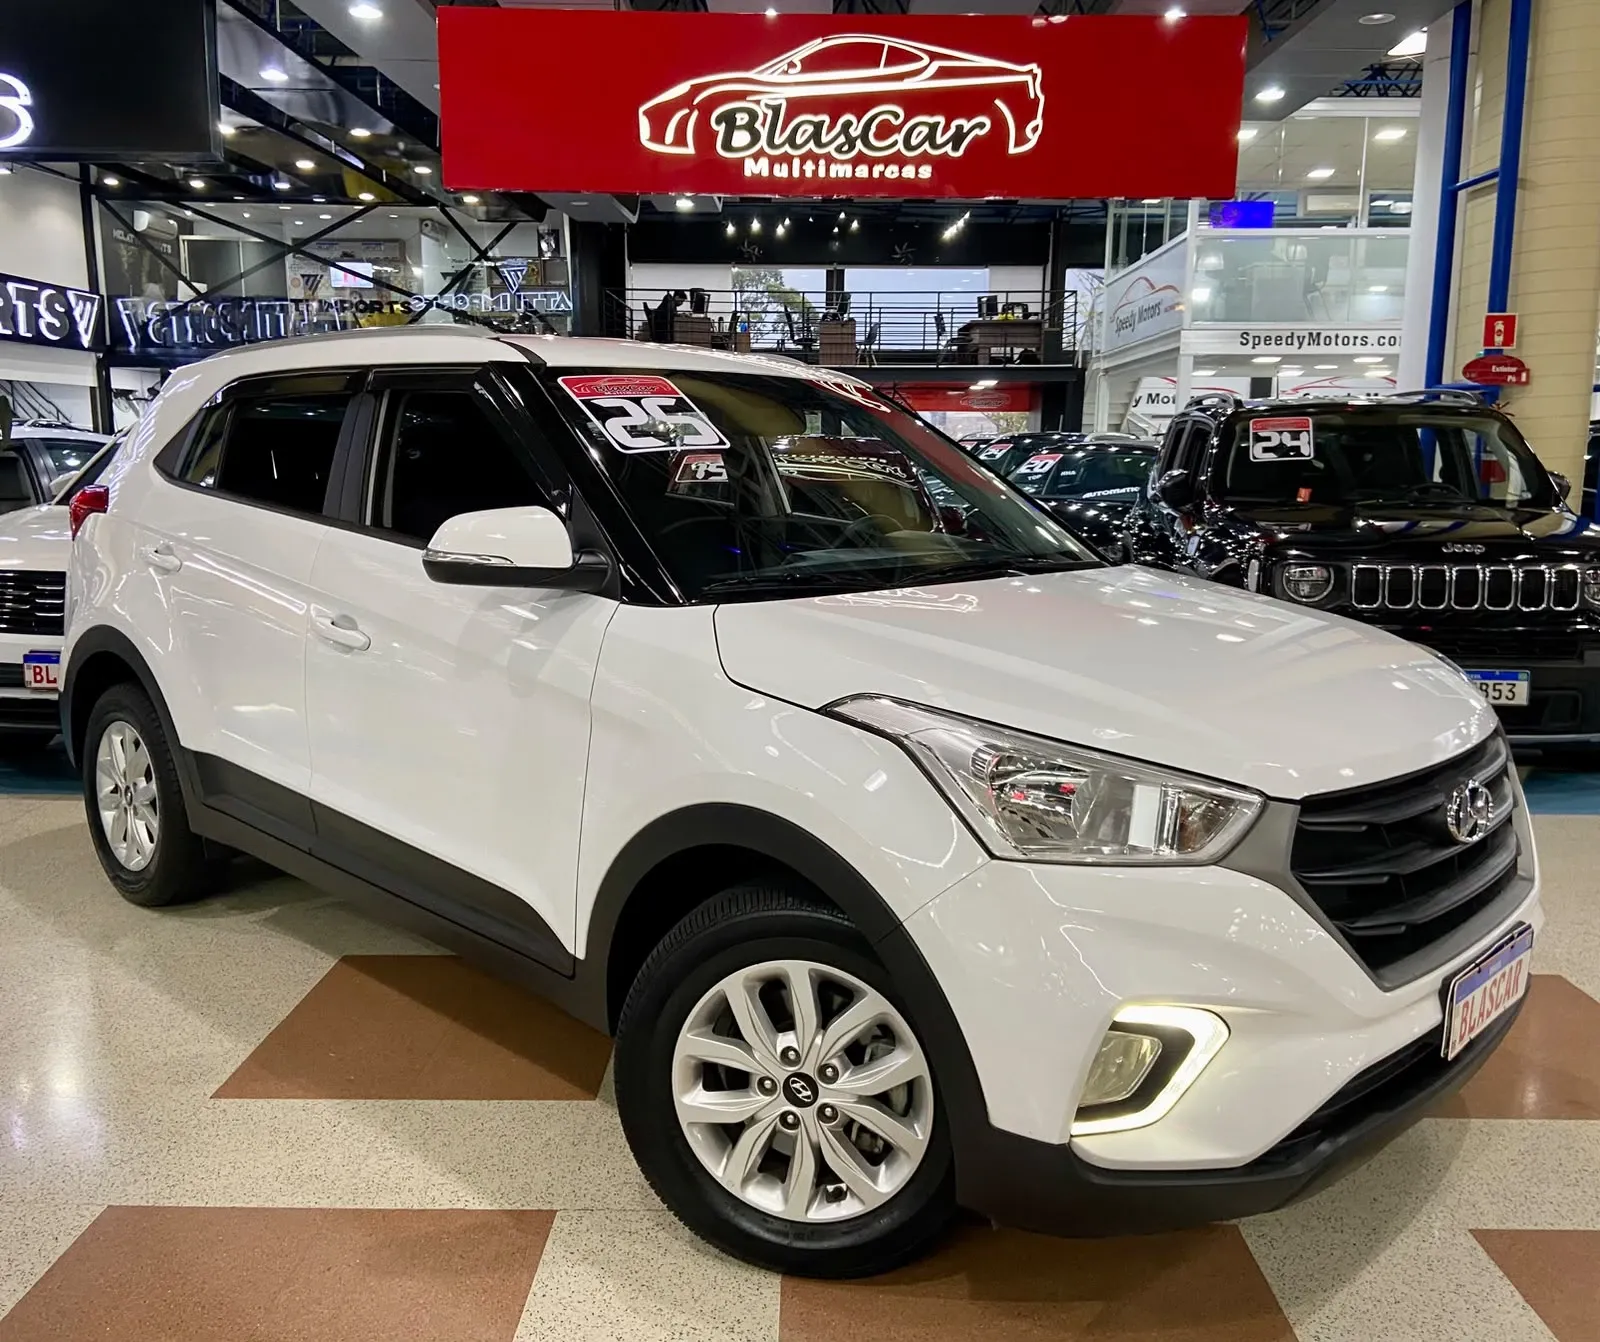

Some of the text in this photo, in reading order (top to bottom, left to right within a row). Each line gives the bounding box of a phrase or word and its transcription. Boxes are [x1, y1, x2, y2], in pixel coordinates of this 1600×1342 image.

[713, 99, 989, 157] BlasCar
[743, 157, 932, 179] Multimarcas
[1115, 309, 1136, 338] Speedy
[1240, 332, 1402, 350] SpeedyMotors.co
[591, 398, 720, 448] 25
[1253, 431, 1310, 459] 24
[1020, 460, 1053, 473] 20
[1441, 542, 1486, 555] Jeep
[33, 665, 57, 684] BL
[1473, 682, 1516, 701] B53
[1458, 958, 1524, 1044] BLASCAR
